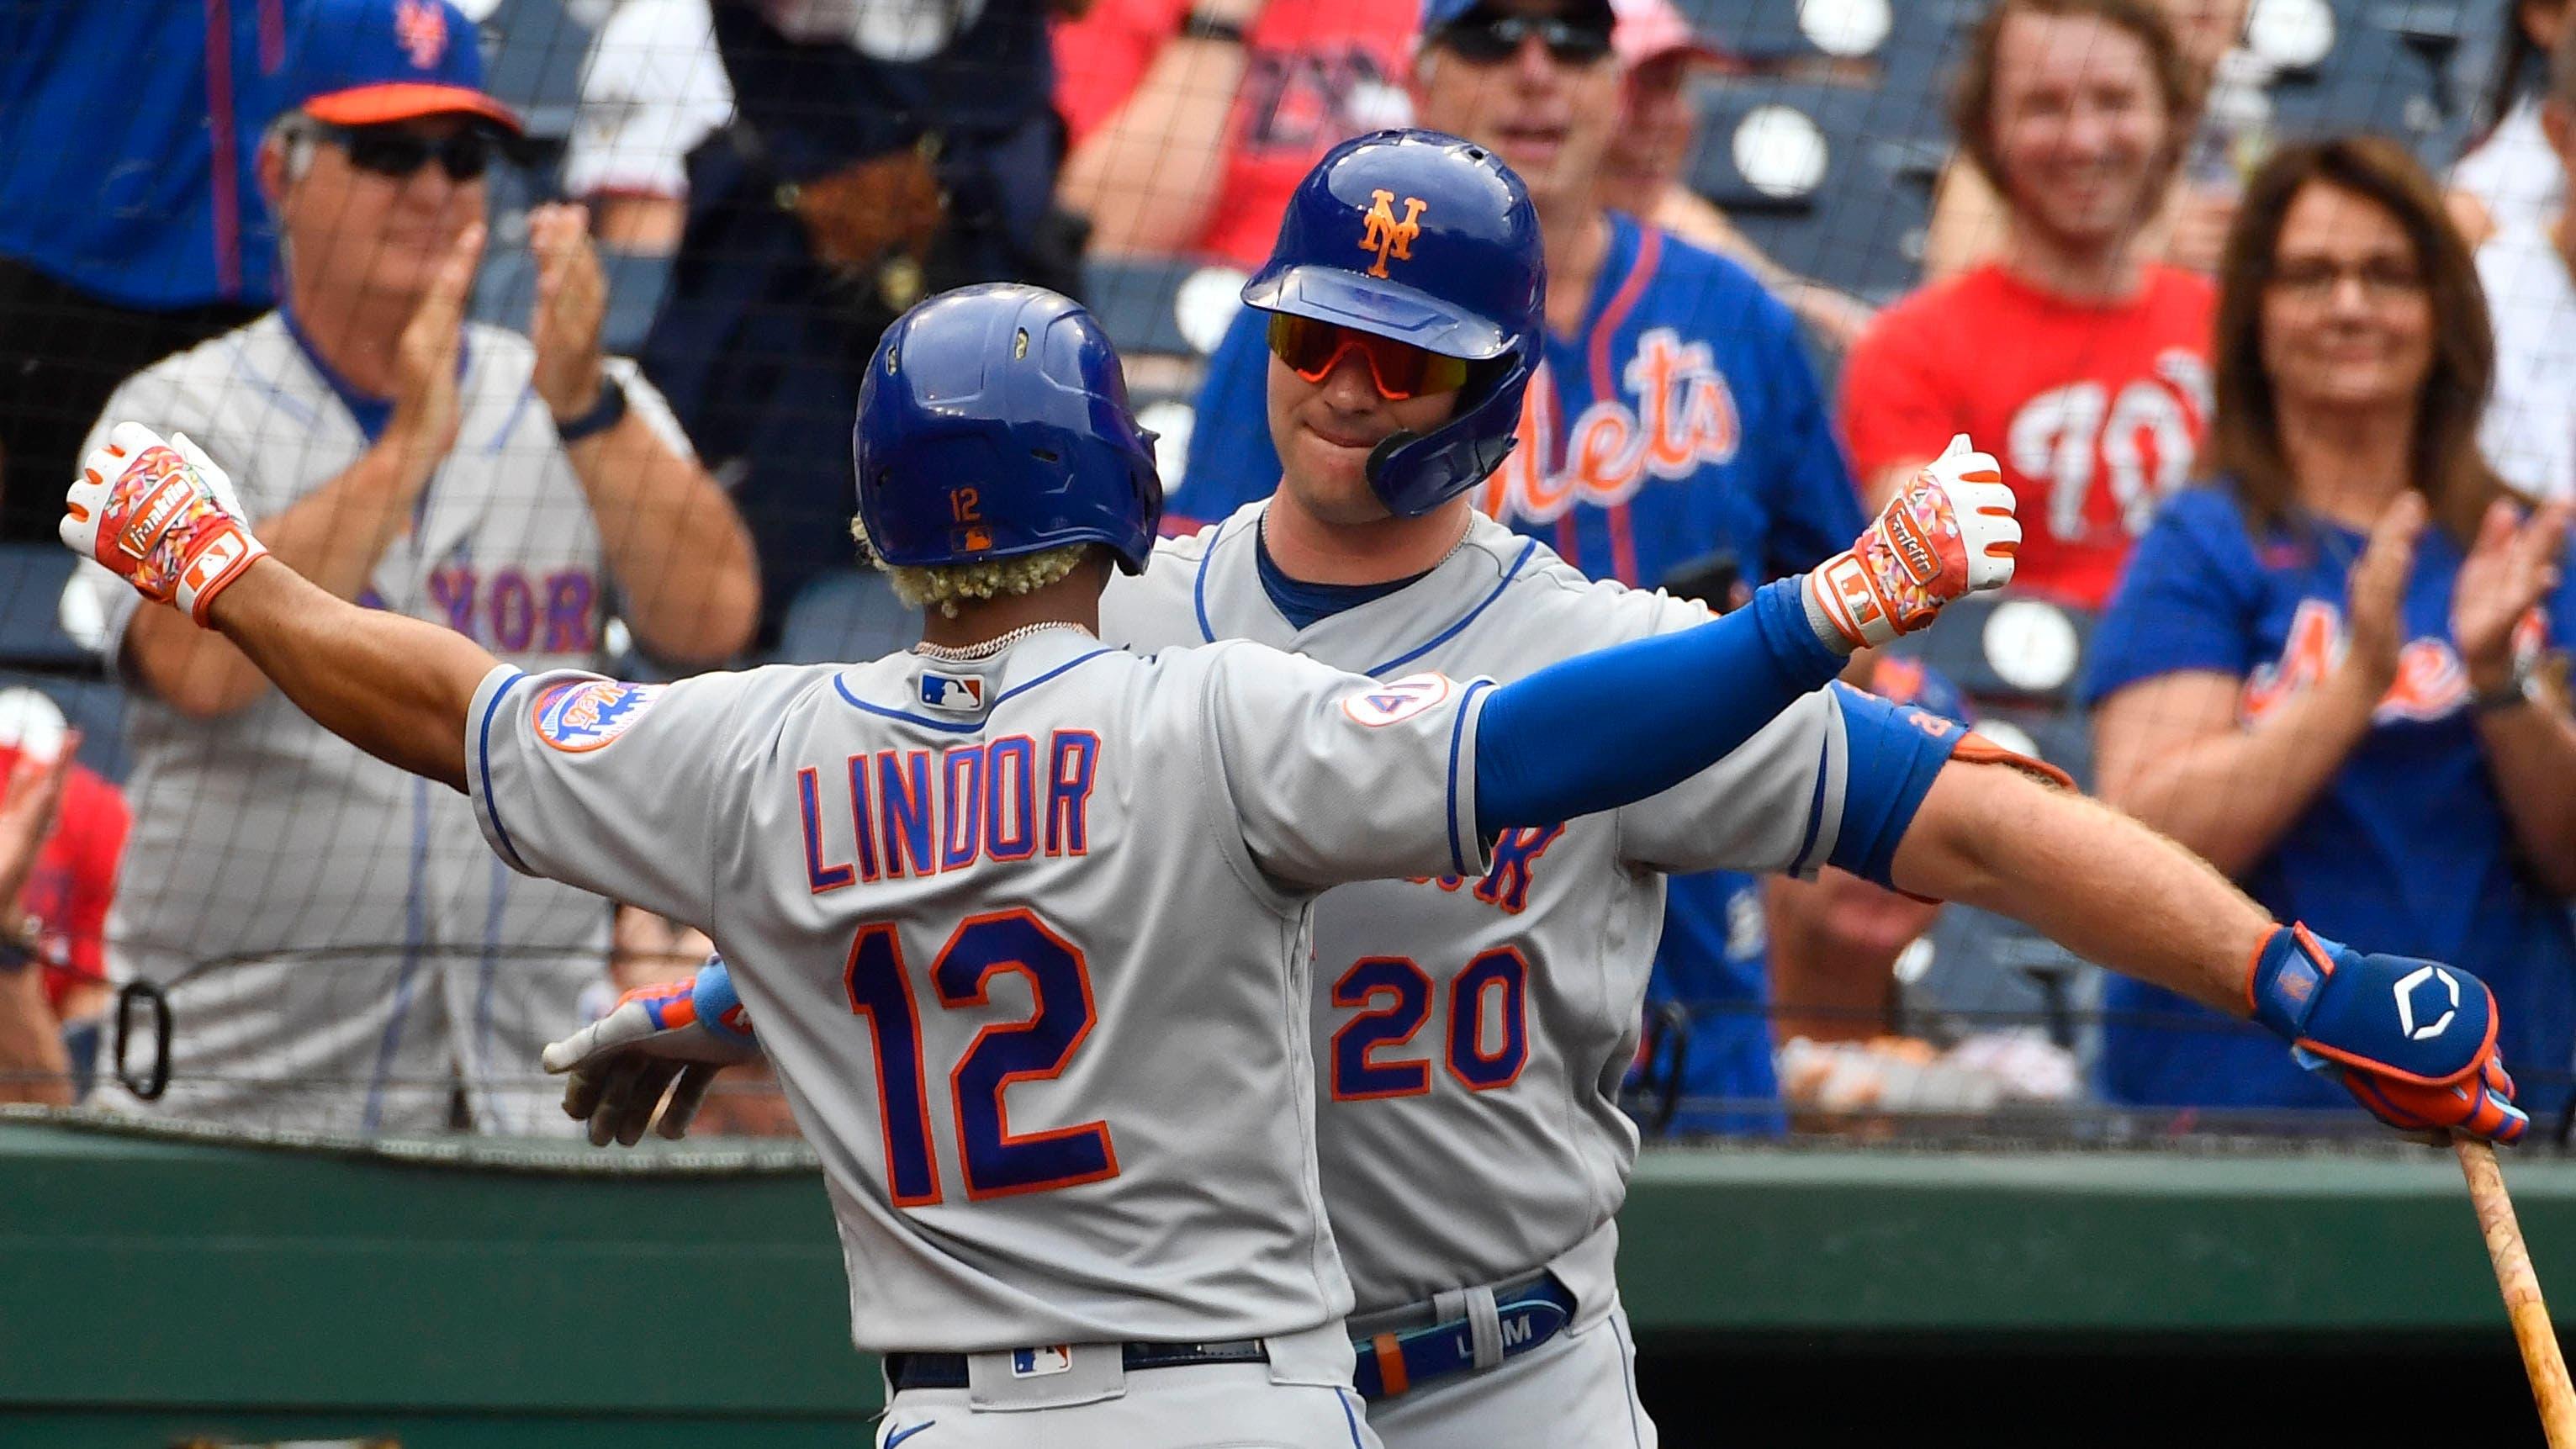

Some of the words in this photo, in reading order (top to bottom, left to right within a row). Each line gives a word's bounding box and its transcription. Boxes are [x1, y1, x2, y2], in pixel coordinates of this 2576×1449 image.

[949, 487, 981, 522] 12
[797, 727, 1102, 894] LINDOR
[844, 907, 1120, 1208] 12
[1331, 944, 1529, 1103] 20
[1456, 1313, 1533, 1360] LM
